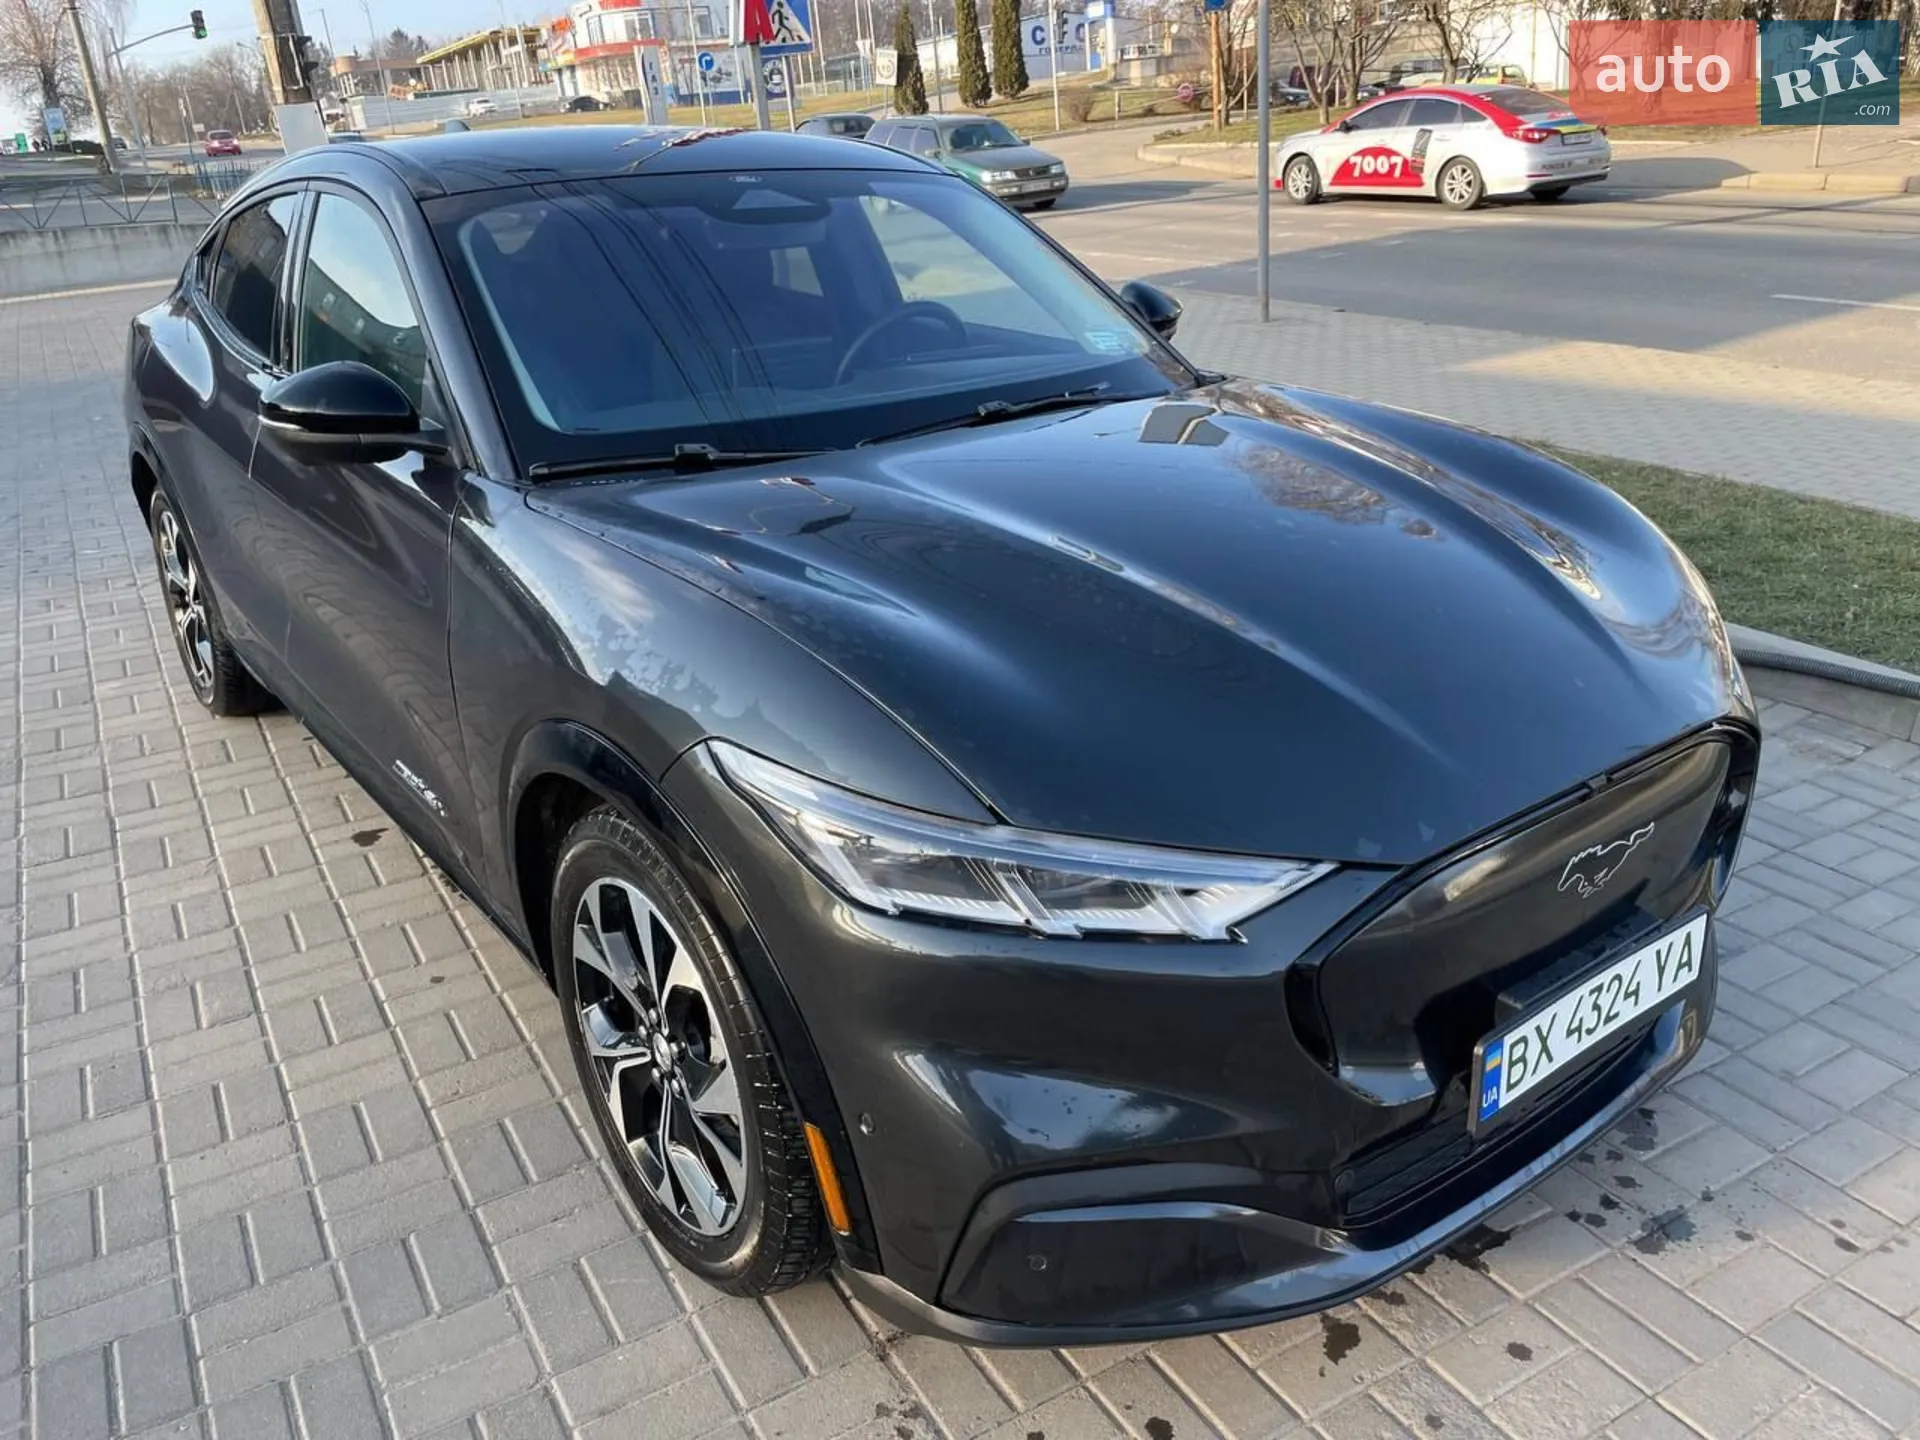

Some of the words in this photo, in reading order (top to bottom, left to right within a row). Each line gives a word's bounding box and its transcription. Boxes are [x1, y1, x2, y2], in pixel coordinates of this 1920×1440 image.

[1348, 155, 1404, 179] 7007
[1505, 1011, 1558, 1094] BX
[1565, 958, 1642, 1044] 4324
[1655, 930, 1694, 993] YA
[1482, 1086, 1498, 1108] UA
